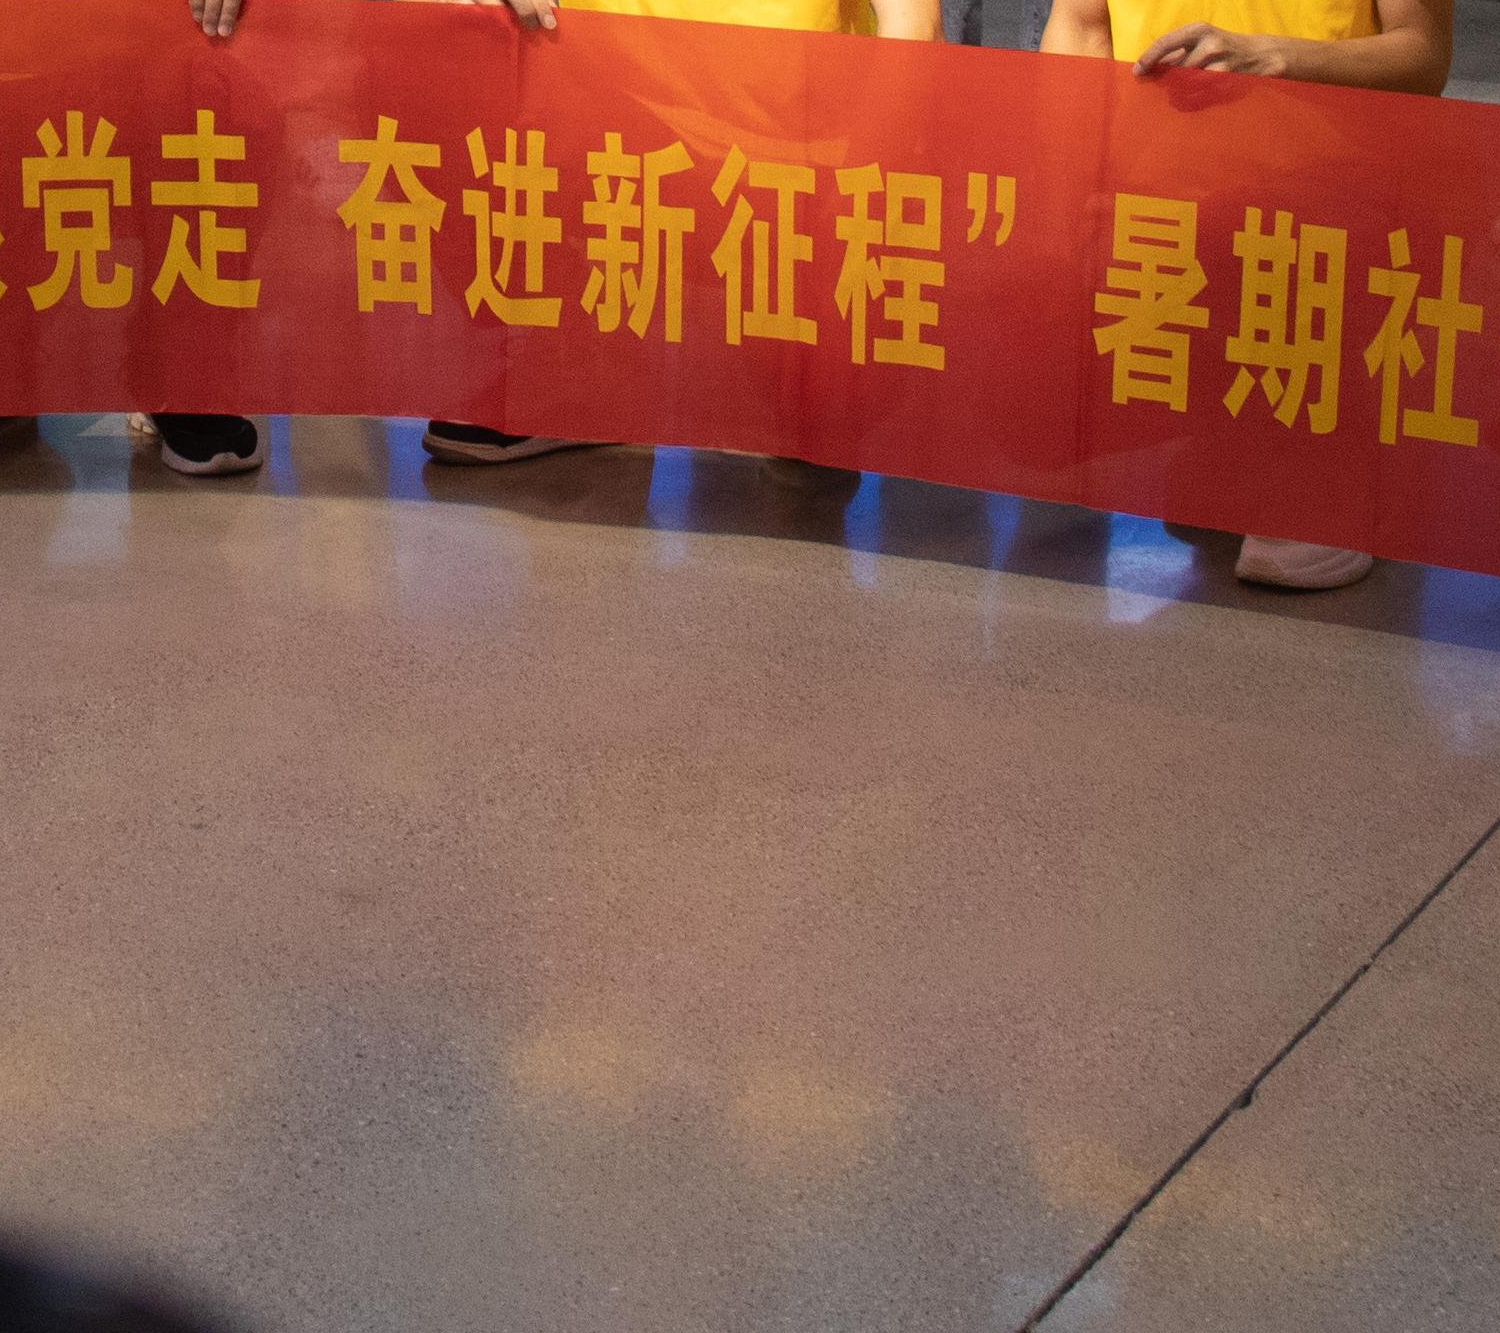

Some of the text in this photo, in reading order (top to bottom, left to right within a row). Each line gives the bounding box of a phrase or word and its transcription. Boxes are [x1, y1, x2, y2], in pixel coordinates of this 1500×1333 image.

[337, 115, 1017, 370] 奋进新征程”
